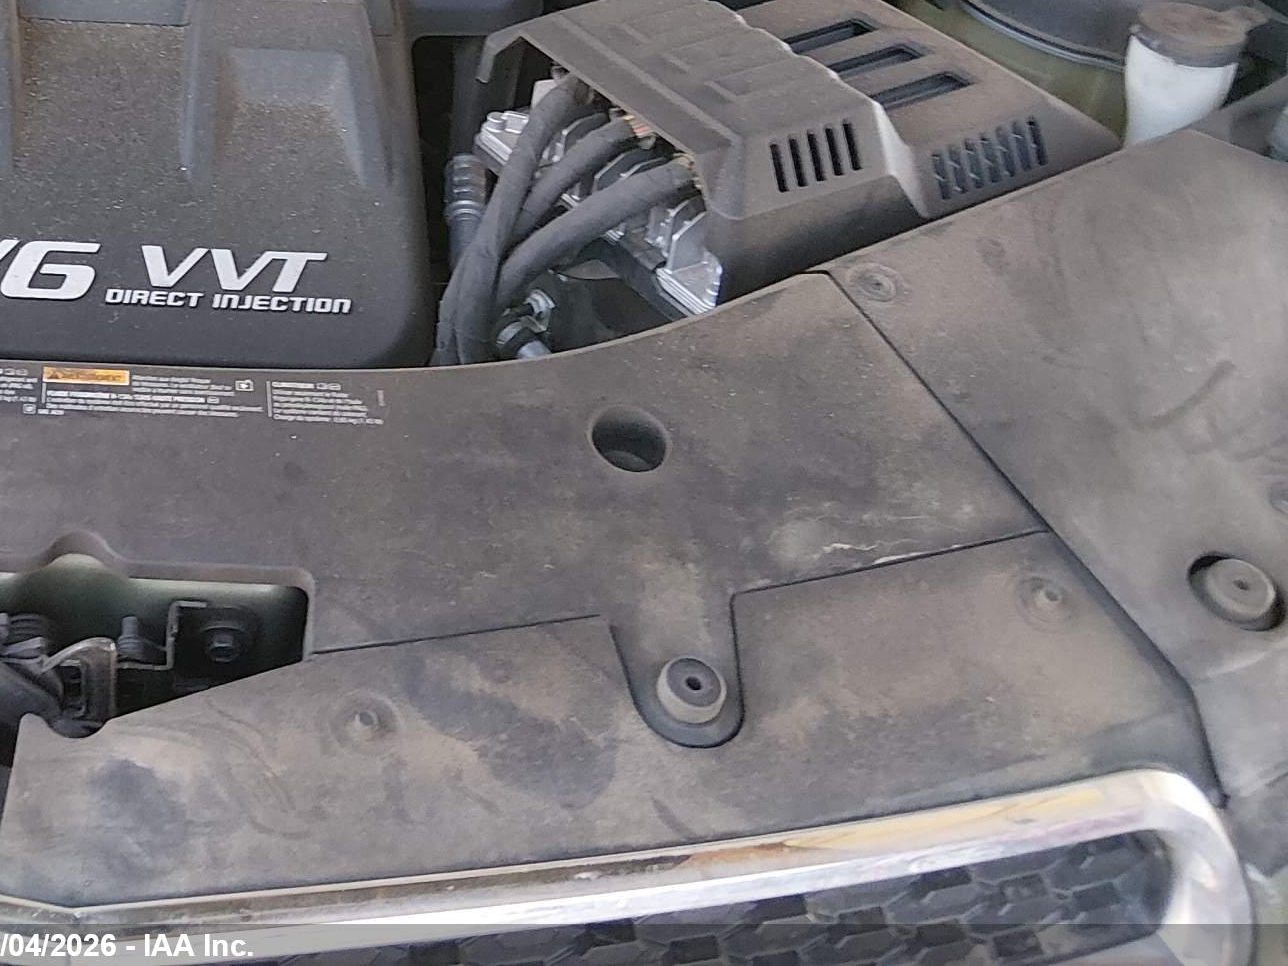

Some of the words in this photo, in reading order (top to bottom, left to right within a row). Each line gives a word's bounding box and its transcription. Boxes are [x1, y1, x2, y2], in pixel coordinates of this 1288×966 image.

[140, 245, 328, 292] VVT
[105, 289, 203, 308] DIRECT
[212, 294, 351, 314] INJECTION
